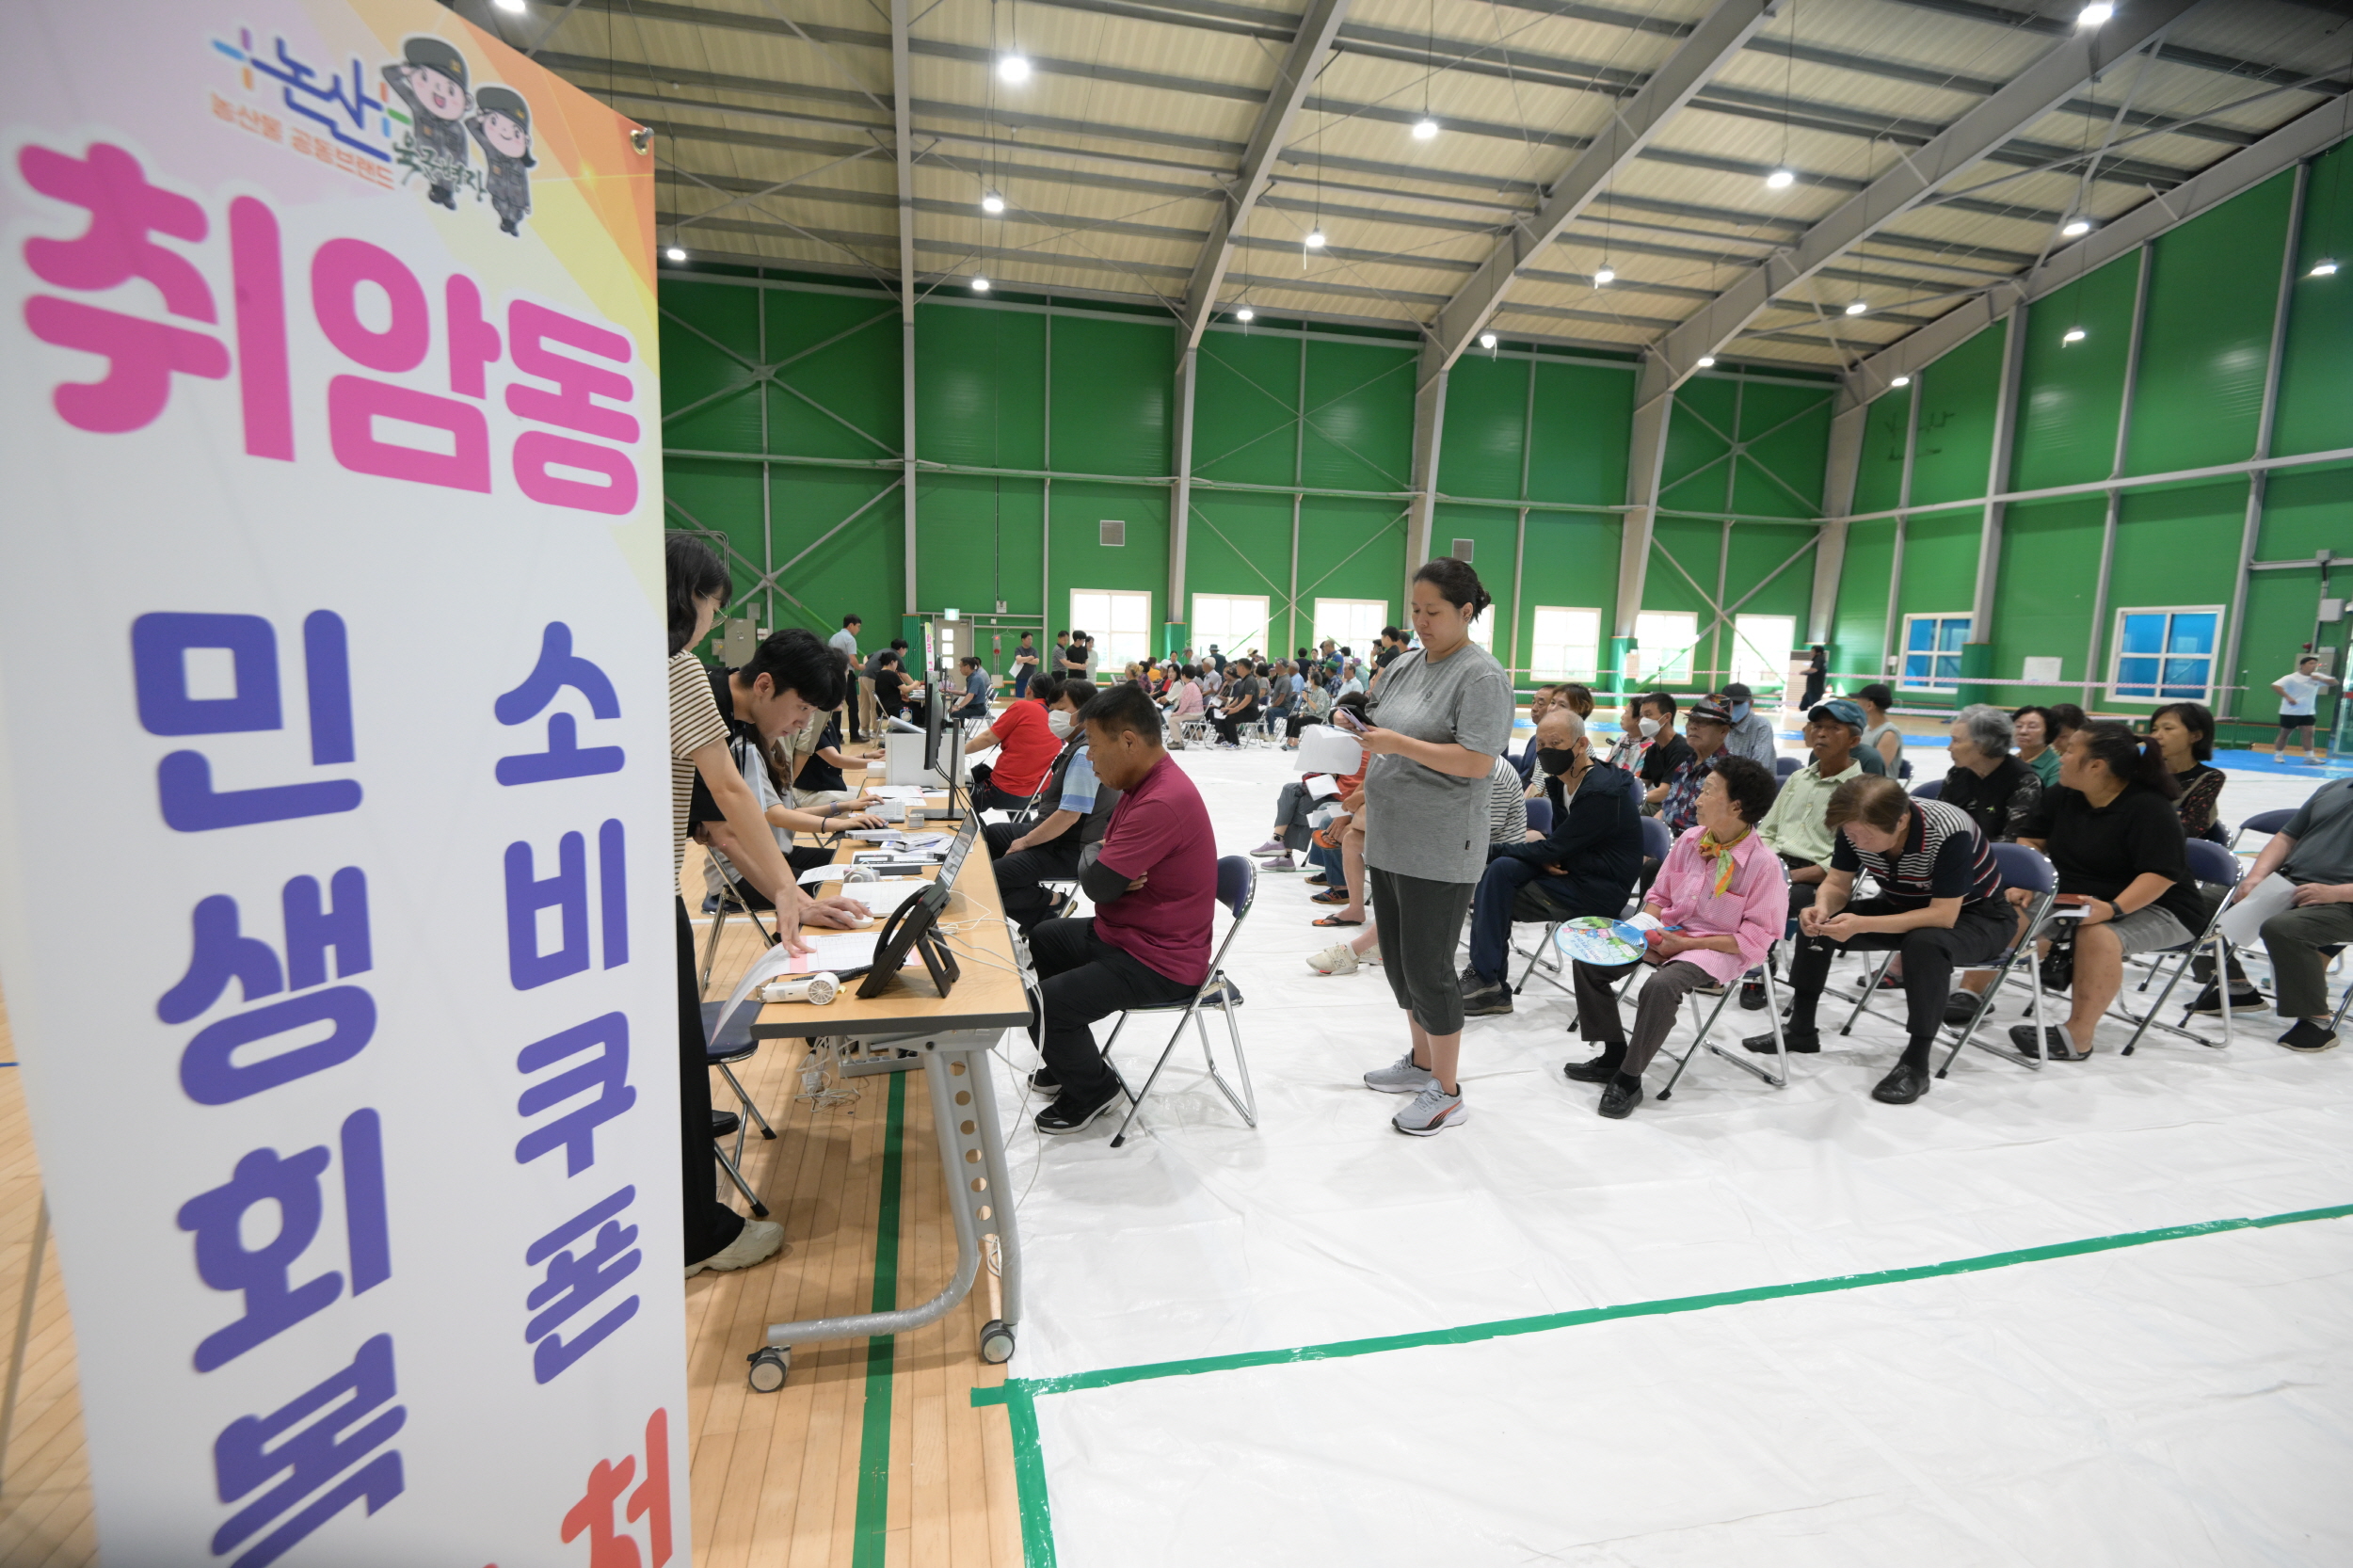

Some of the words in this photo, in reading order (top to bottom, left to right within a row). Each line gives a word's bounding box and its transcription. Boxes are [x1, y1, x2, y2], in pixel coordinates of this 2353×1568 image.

[18, 141, 641, 517] 취암동
[248, 35, 392, 163] 논산
[131, 609, 408, 1568] 민생회복
[494, 621, 643, 1384] 소비쿠폰
